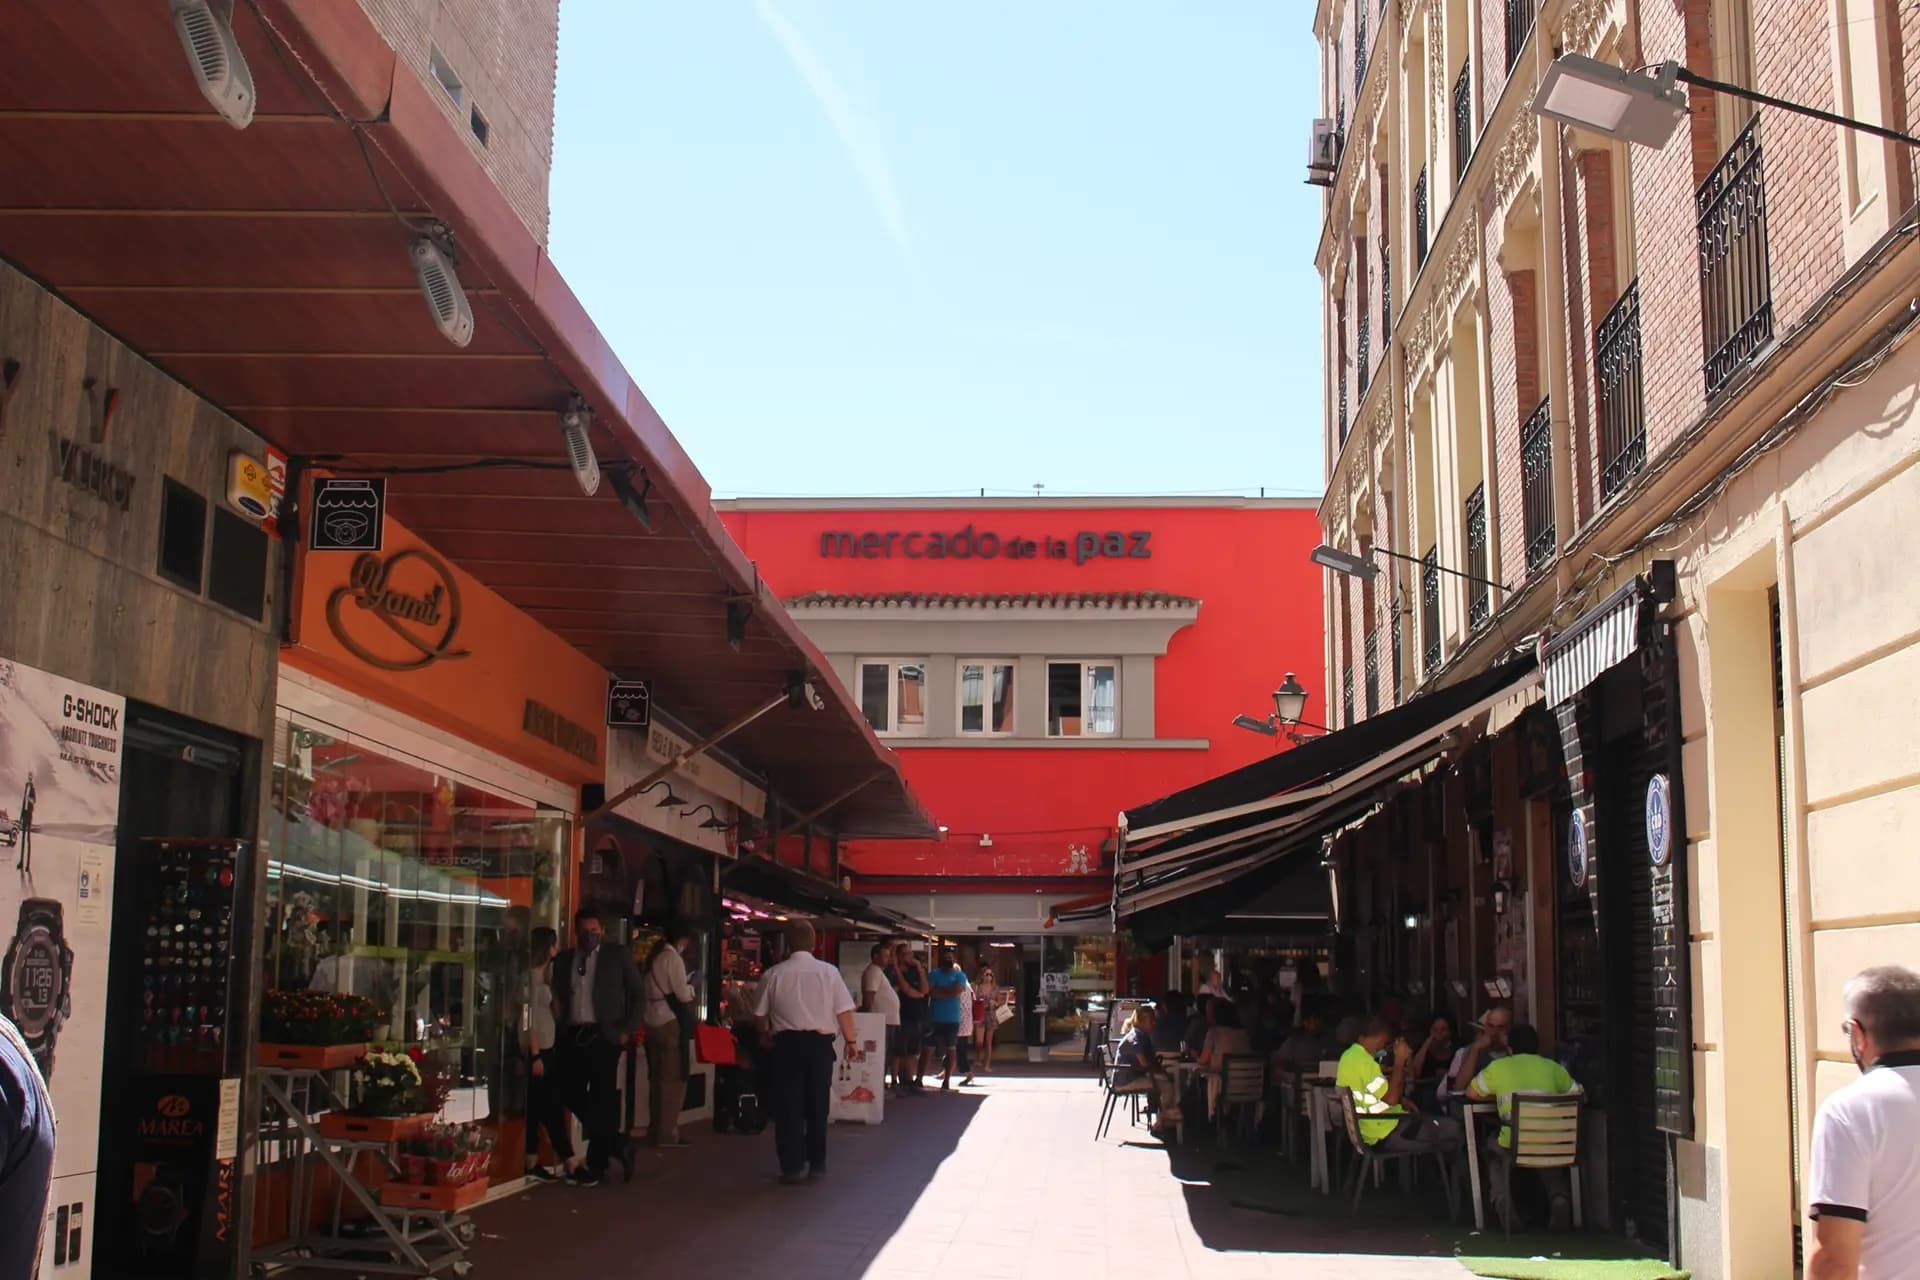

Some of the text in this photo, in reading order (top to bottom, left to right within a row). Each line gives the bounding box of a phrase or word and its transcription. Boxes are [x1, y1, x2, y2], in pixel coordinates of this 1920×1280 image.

[820, 524, 1152, 566] mercado de la paz
[63, 693, 119, 732] G-SHOCK
